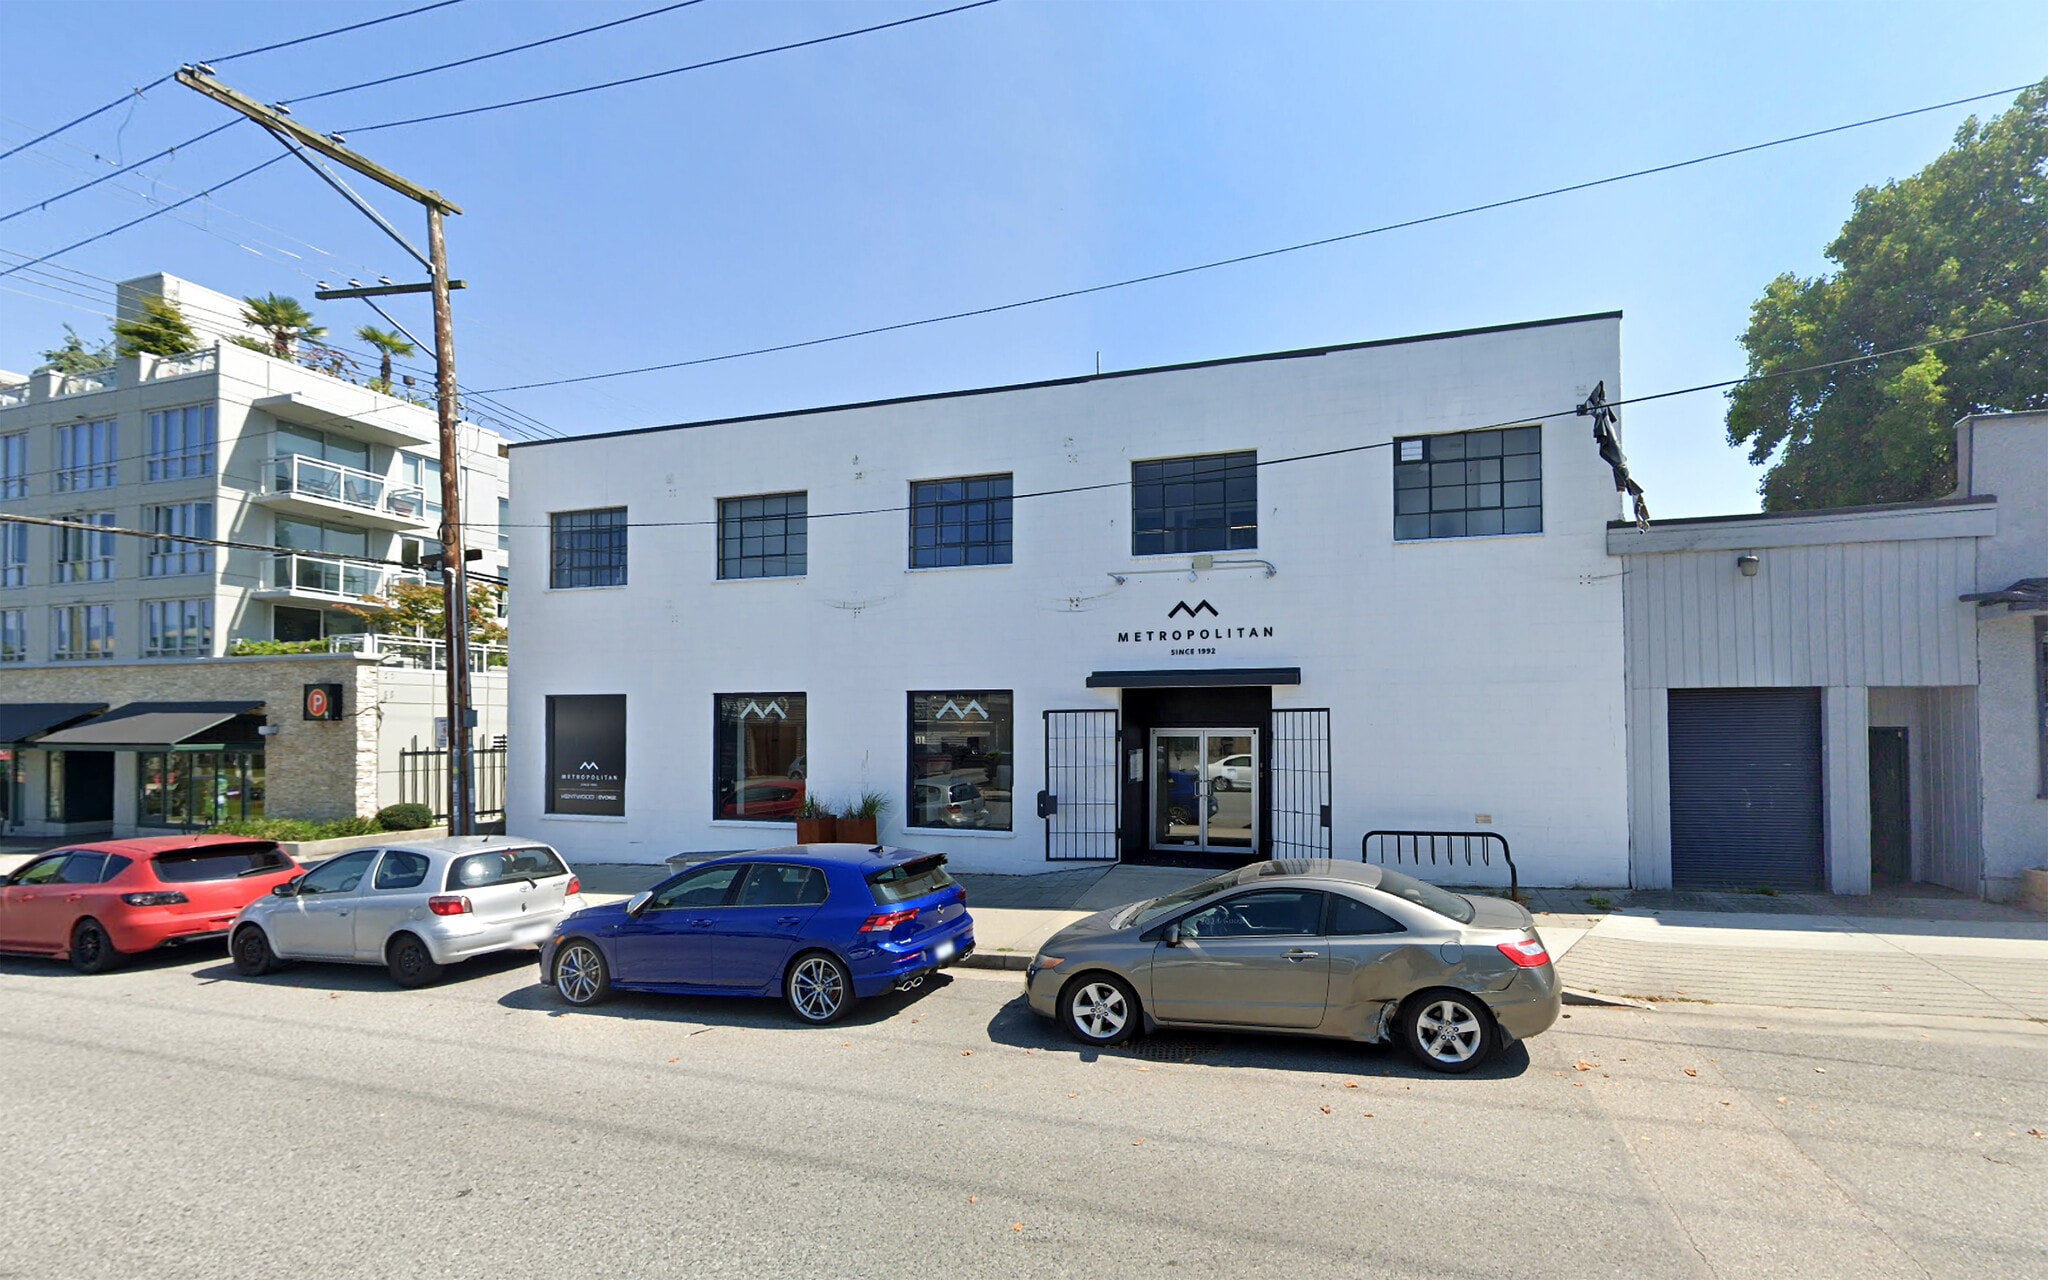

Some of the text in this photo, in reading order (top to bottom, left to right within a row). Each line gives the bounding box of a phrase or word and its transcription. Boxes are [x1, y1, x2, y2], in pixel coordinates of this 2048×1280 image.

[1117, 626, 1274, 643] METROPOLITAN
[1170, 647, 1216, 656] SINCE 1992
[313, 694, 323, 712] P
